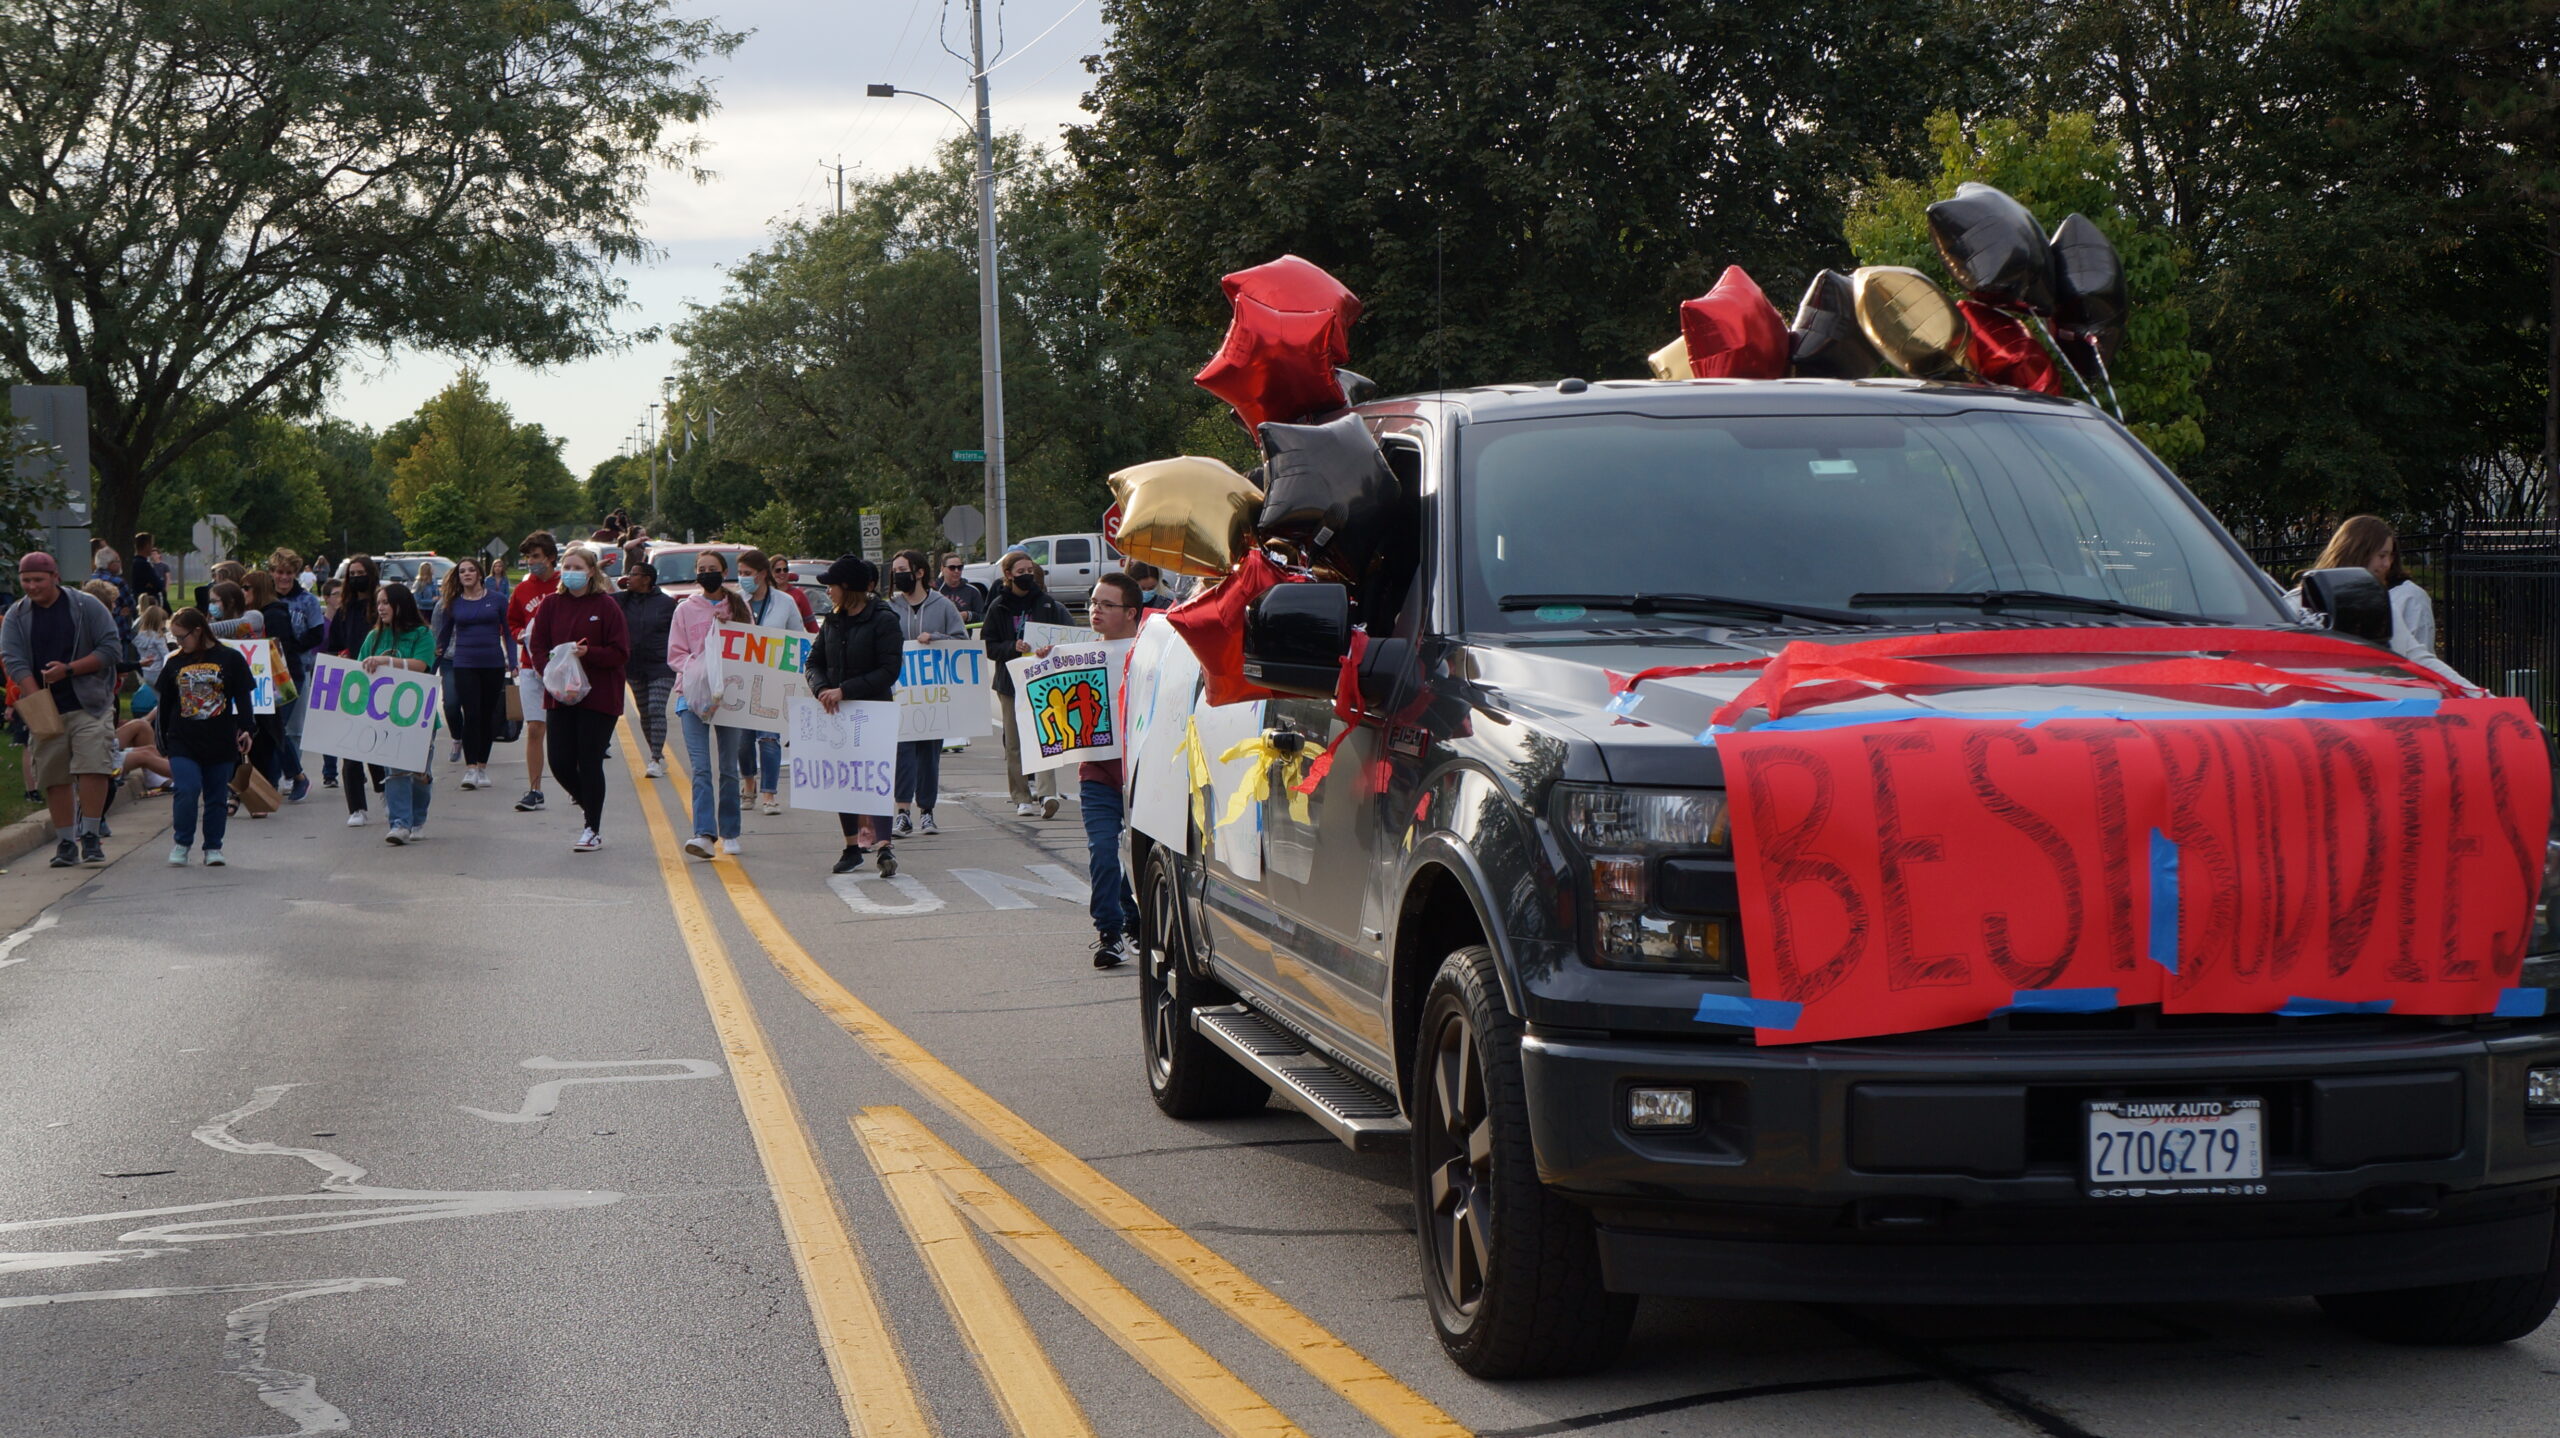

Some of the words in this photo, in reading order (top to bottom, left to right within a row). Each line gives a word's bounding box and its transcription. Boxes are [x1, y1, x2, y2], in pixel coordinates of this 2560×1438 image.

[862, 526, 880, 537] 20
[1024, 660, 1050, 679] BEST
[1053, 650, 1107, 669] BUDDIES
[309, 664, 437, 729] HOCO!
[793, 756, 892, 797] BUDDIES
[1740, 726, 2140, 1005] BEST
[2143, 711, 2536, 998] BUDDIES
[2127, 1103, 2175, 1118] HAWK
[2178, 1102, 2222, 1116] AUTO
[2096, 1128, 2240, 1176] 2706279
